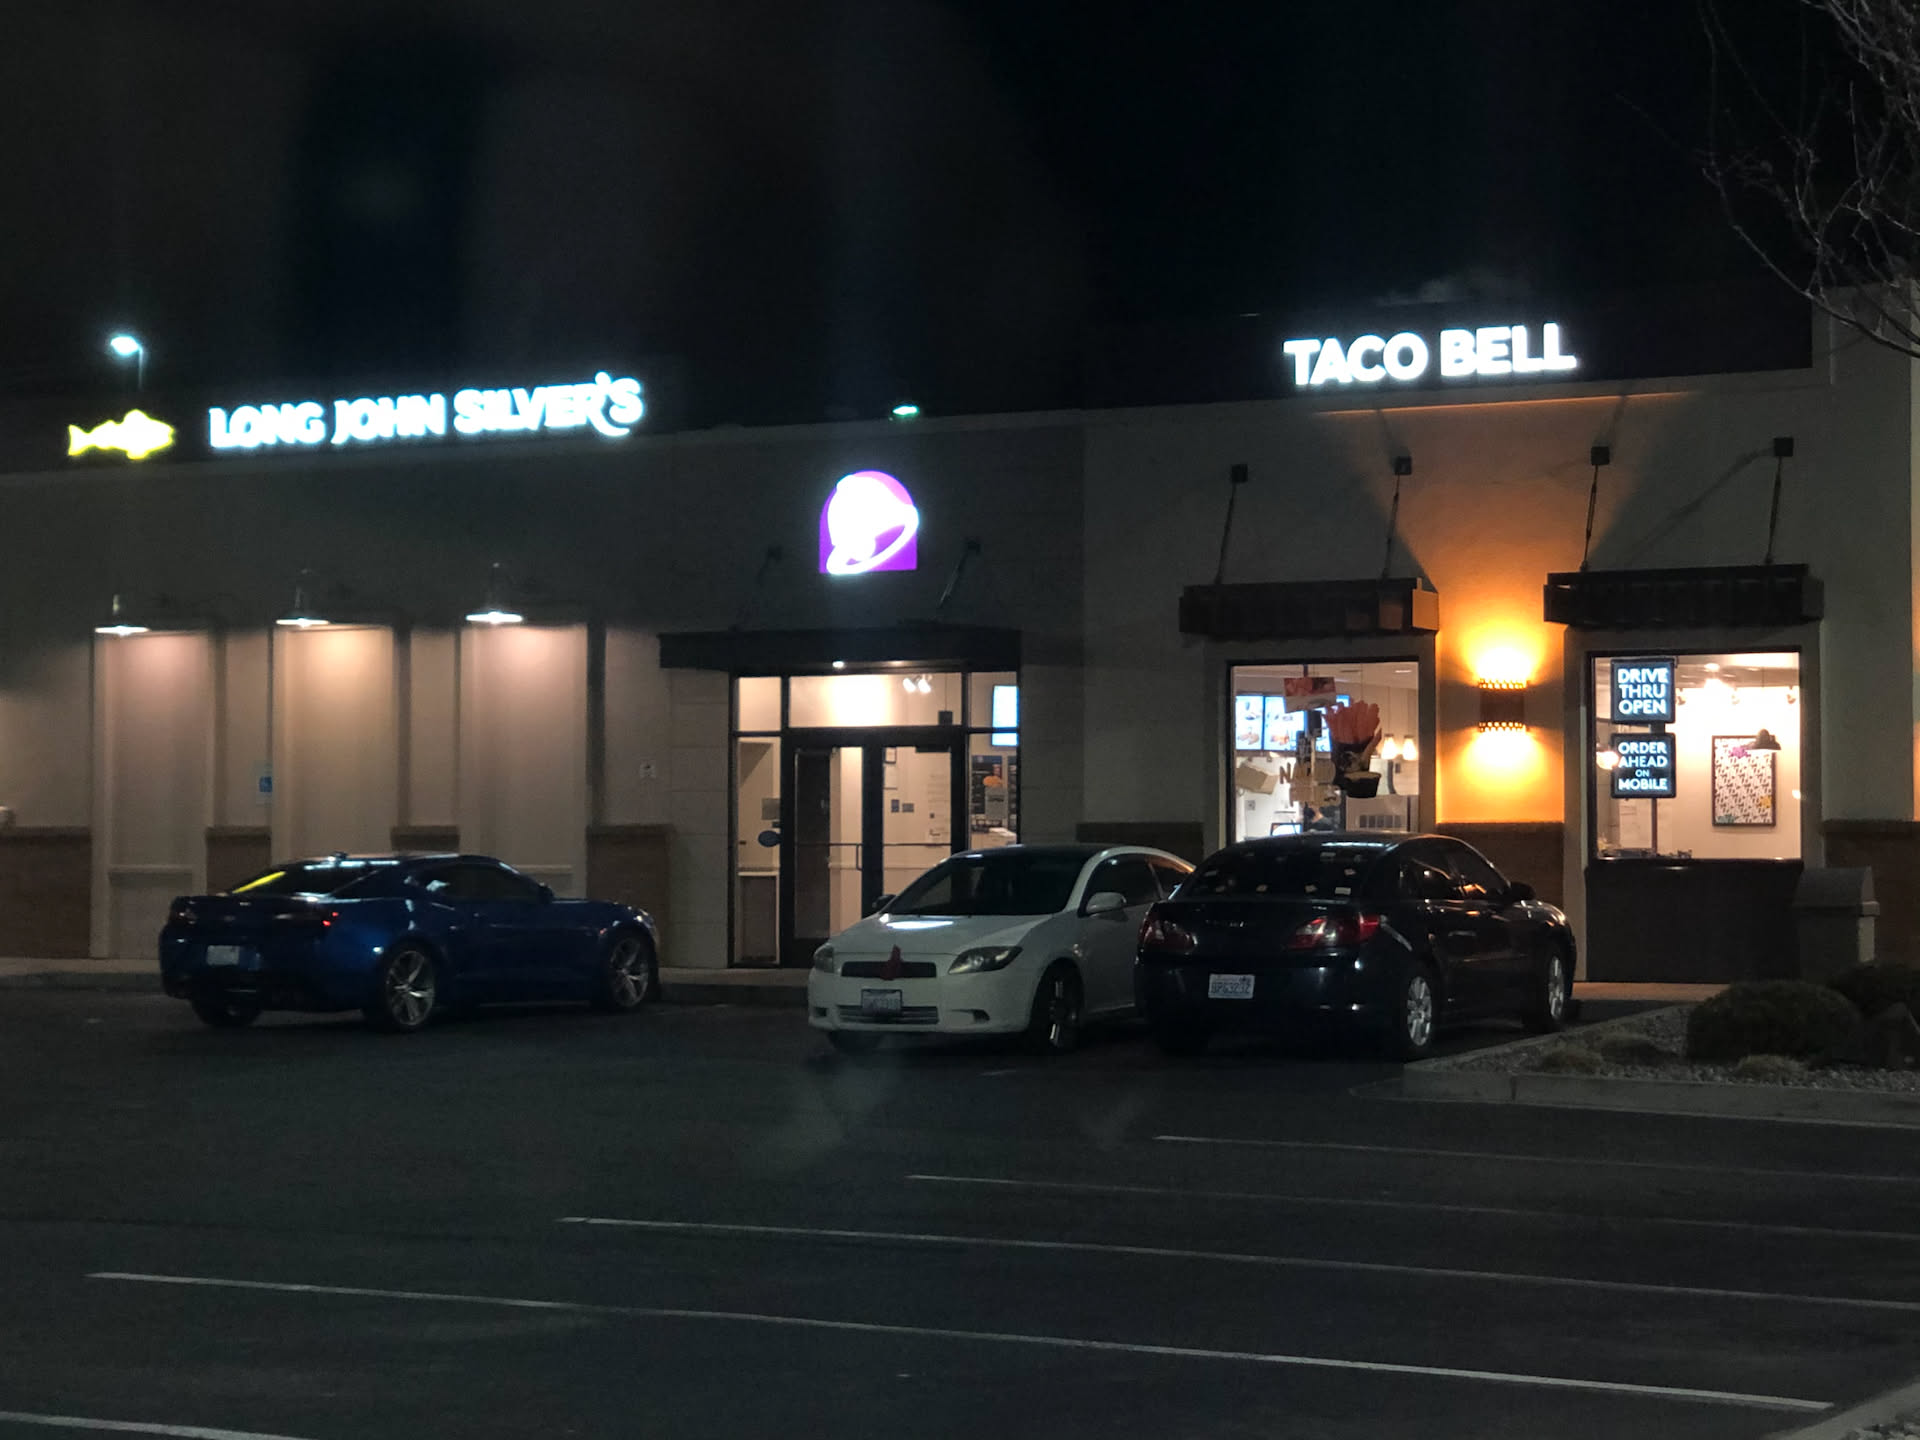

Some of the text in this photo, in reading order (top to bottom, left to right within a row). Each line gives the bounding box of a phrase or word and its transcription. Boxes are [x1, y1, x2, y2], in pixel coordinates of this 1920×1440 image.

[1283, 322, 1578, 386] TACO BELL
[208, 371, 645, 449] LONG JOHN SILVER'S
[1617, 667, 1668, 683] DRIVE
[1619, 684, 1666, 698] THRU
[1618, 699, 1667, 714] OPEN
[1618, 742, 1667, 754] ORDER
[1618, 755, 1668, 768] AHEAD
[1635, 769, 1650, 777] ON
[1618, 778, 1668, 790] MOBILE
